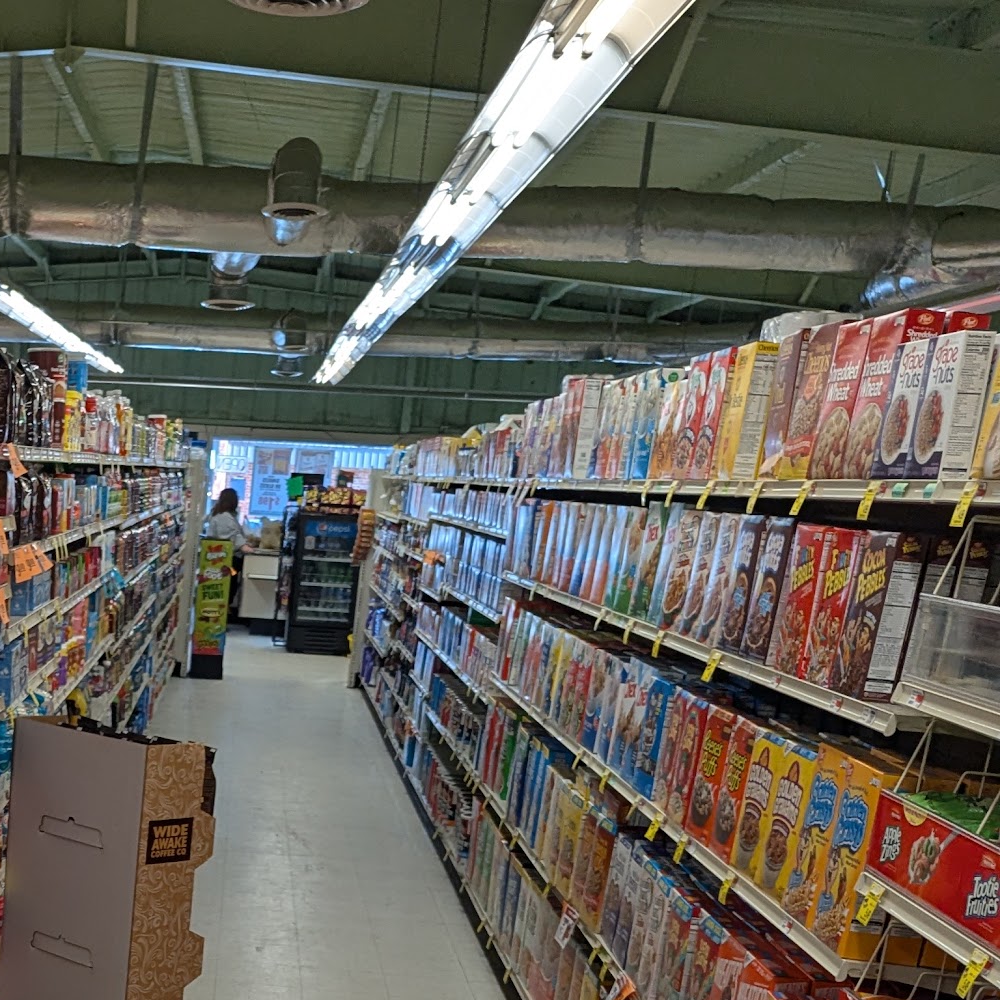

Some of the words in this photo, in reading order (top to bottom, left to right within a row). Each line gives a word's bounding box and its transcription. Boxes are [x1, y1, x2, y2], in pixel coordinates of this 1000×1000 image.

[830, 359, 860, 383] Shredded
[827, 382, 850, 401] Wheat
[862, 548, 886, 573] COCOA
[856, 568, 886, 603] PEBBLES
[153, 823, 190, 839] WIDE
[883, 826, 901, 844] Apple
[150, 849, 176, 859] COFFEE
[176, 848, 187, 856] CO
[151, 836, 188, 851] AWAKE
[974, 876, 999, 899] Tootie
[965, 896, 999, 918] Fruities
